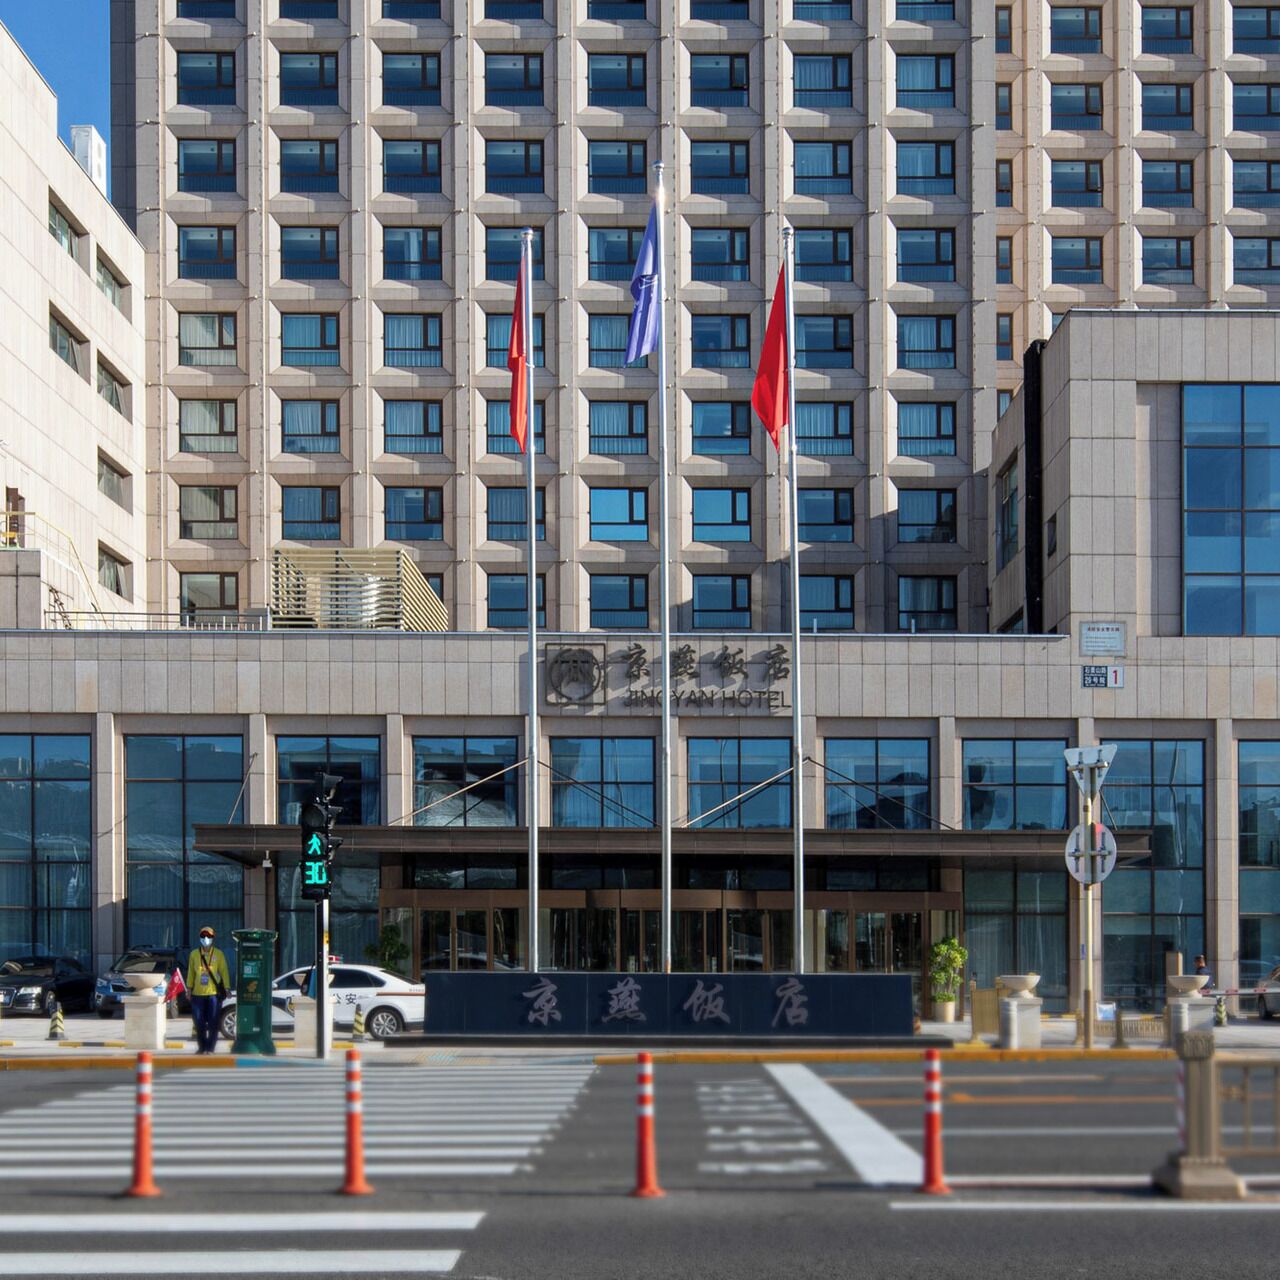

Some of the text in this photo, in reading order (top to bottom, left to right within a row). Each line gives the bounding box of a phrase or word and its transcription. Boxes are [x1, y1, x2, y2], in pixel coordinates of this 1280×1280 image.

[623, 642, 791, 680] 京燕饭店
[1112, 669, 1118, 685] 1
[722, 690, 792, 708] HOTEL
[305, 861, 327, 885] 30
[522, 976, 810, 1027] 京燕饭店
